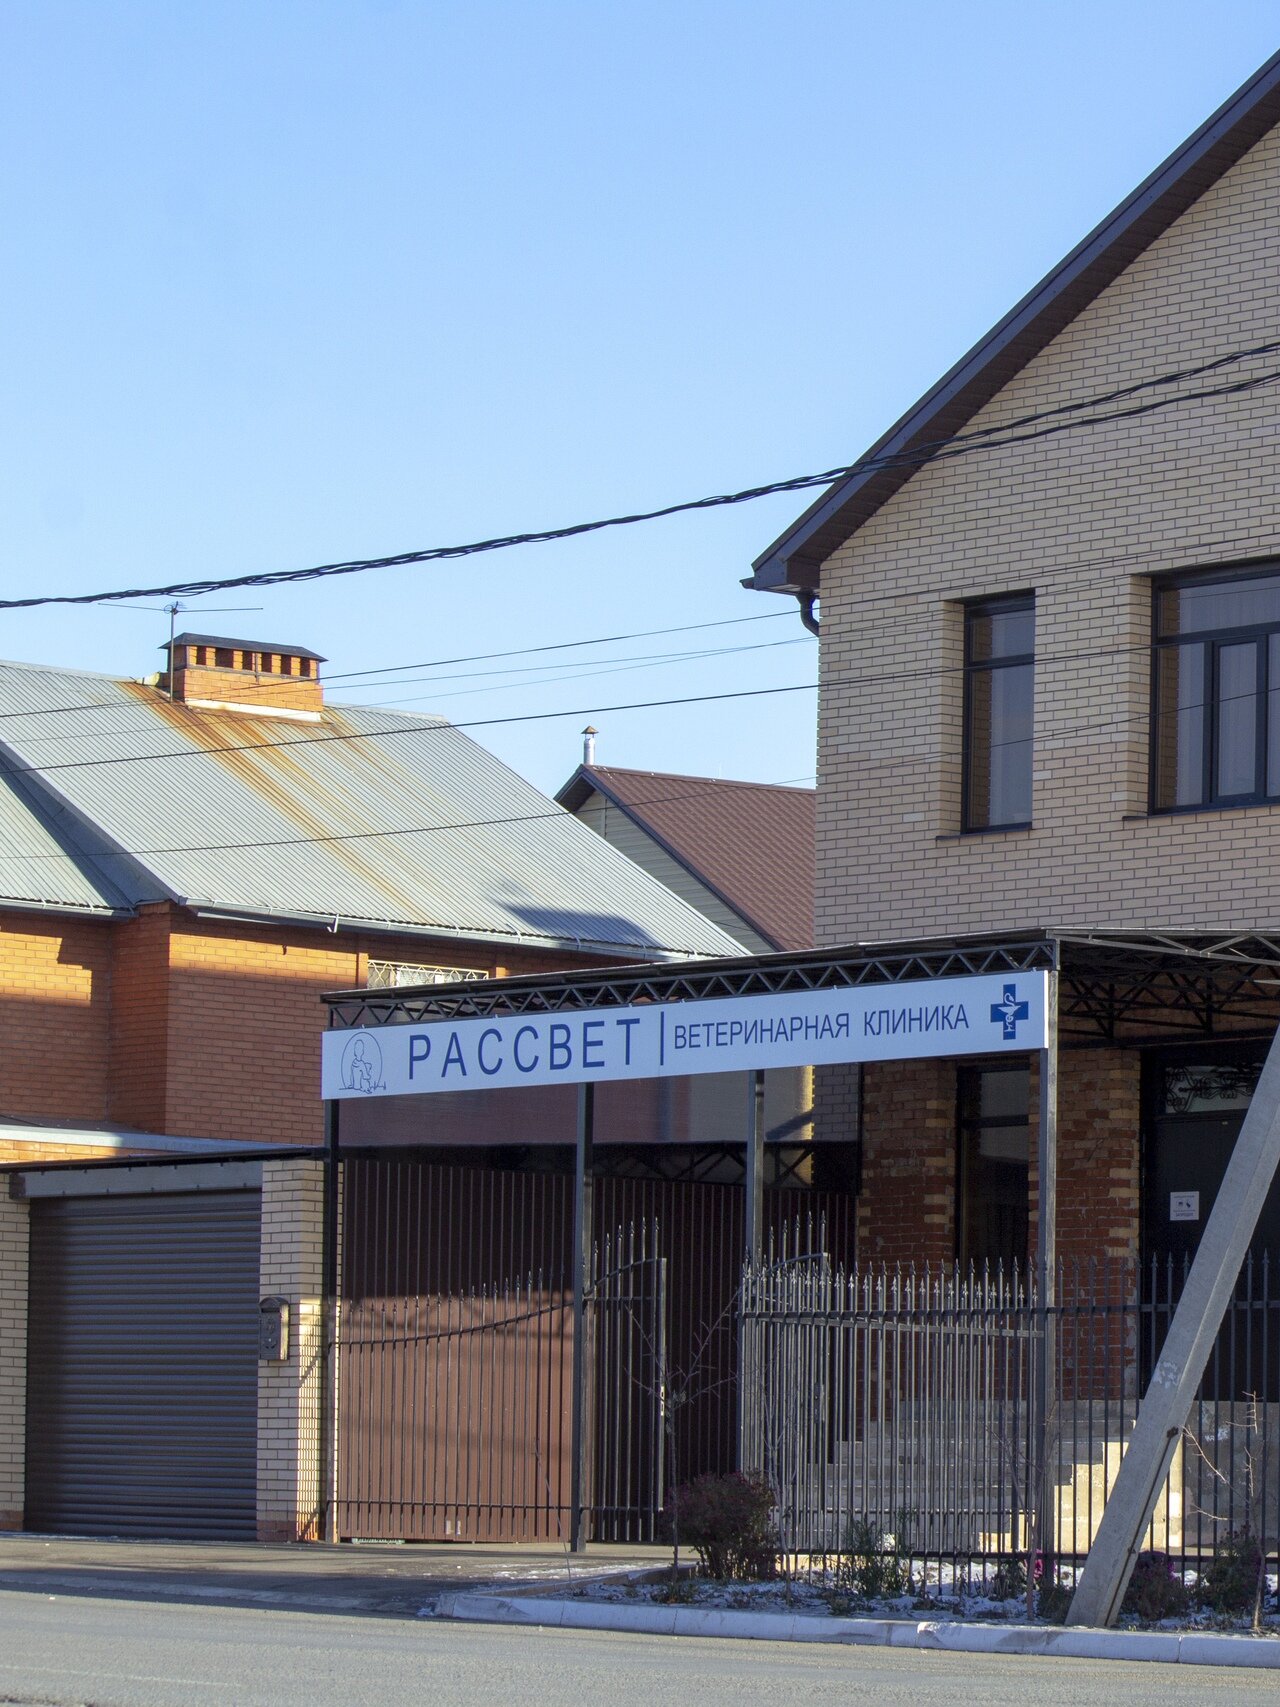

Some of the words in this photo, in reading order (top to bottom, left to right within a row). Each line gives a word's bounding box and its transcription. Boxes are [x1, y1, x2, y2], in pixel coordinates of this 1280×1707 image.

[408, 1017, 641, 1080] РАССВЕТ
[674, 1012, 850, 1050] ВЕТЕРИНАРНАЯ
[863, 1003, 970, 1036] КЛИНИКА
